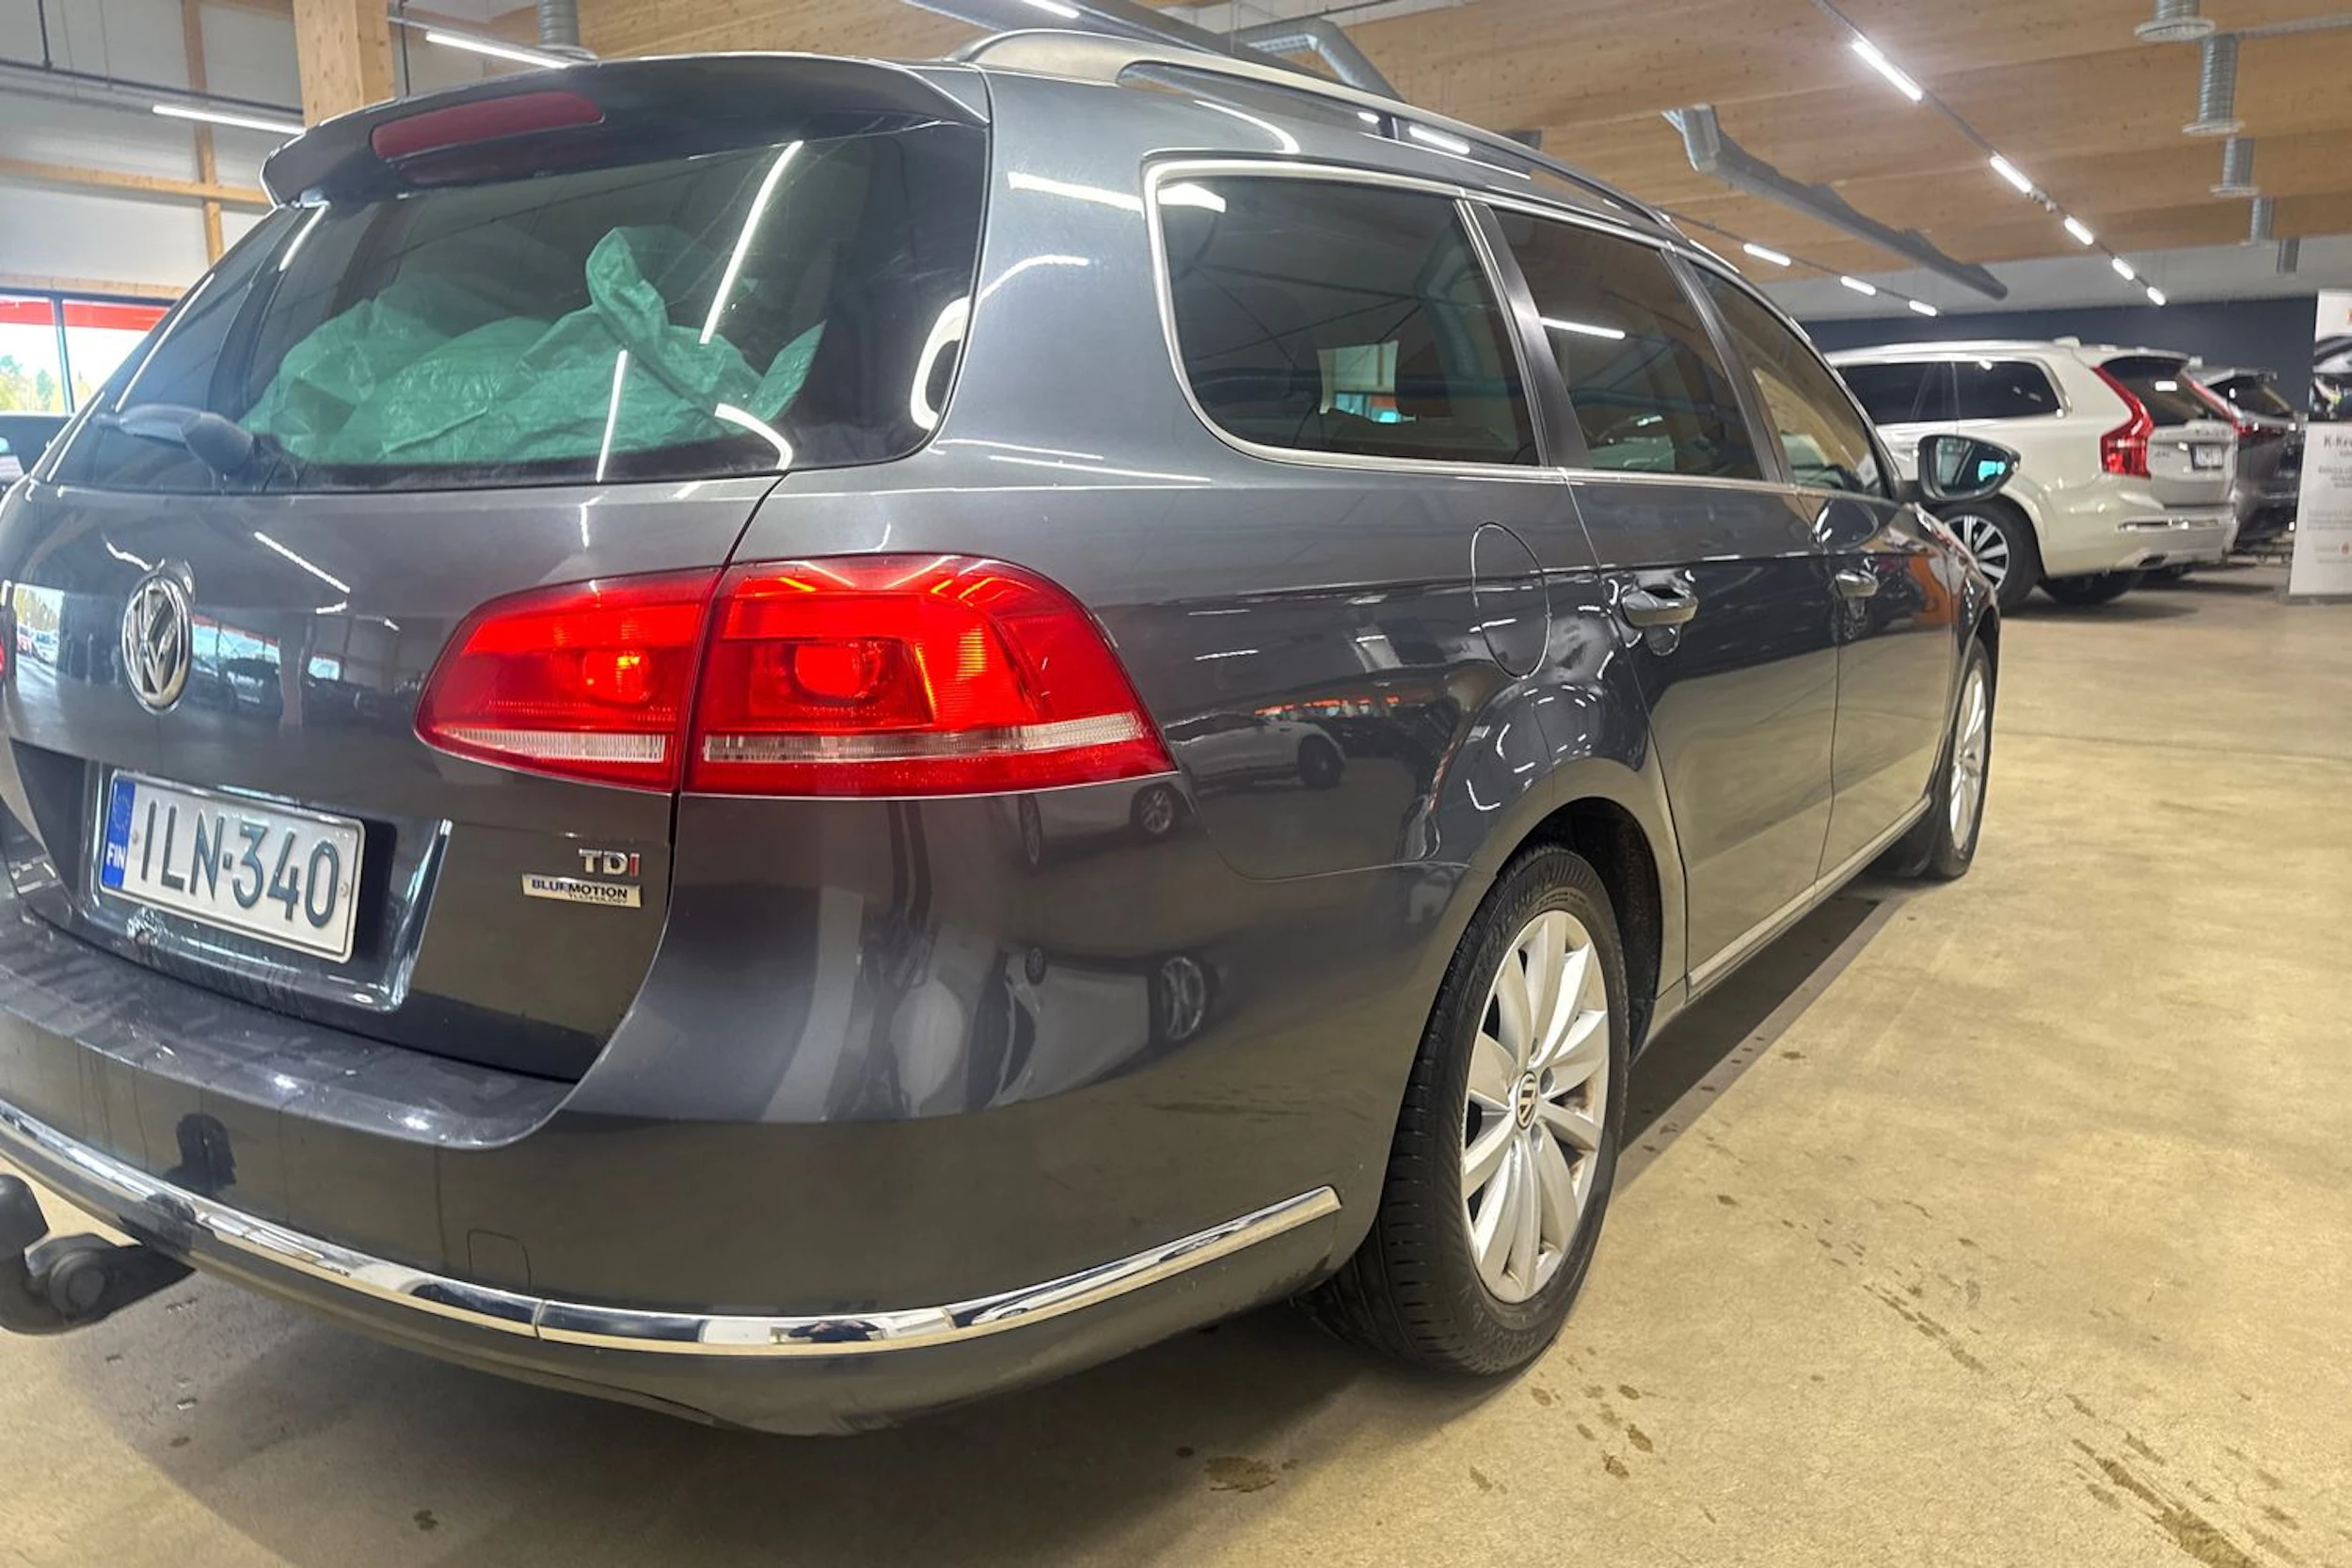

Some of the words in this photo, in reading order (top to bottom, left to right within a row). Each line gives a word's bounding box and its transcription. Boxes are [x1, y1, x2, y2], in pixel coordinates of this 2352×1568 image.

[106, 842, 126, 869] FIN
[141, 800, 340, 928] ILN-340
[579, 848, 641, 877] TDI
